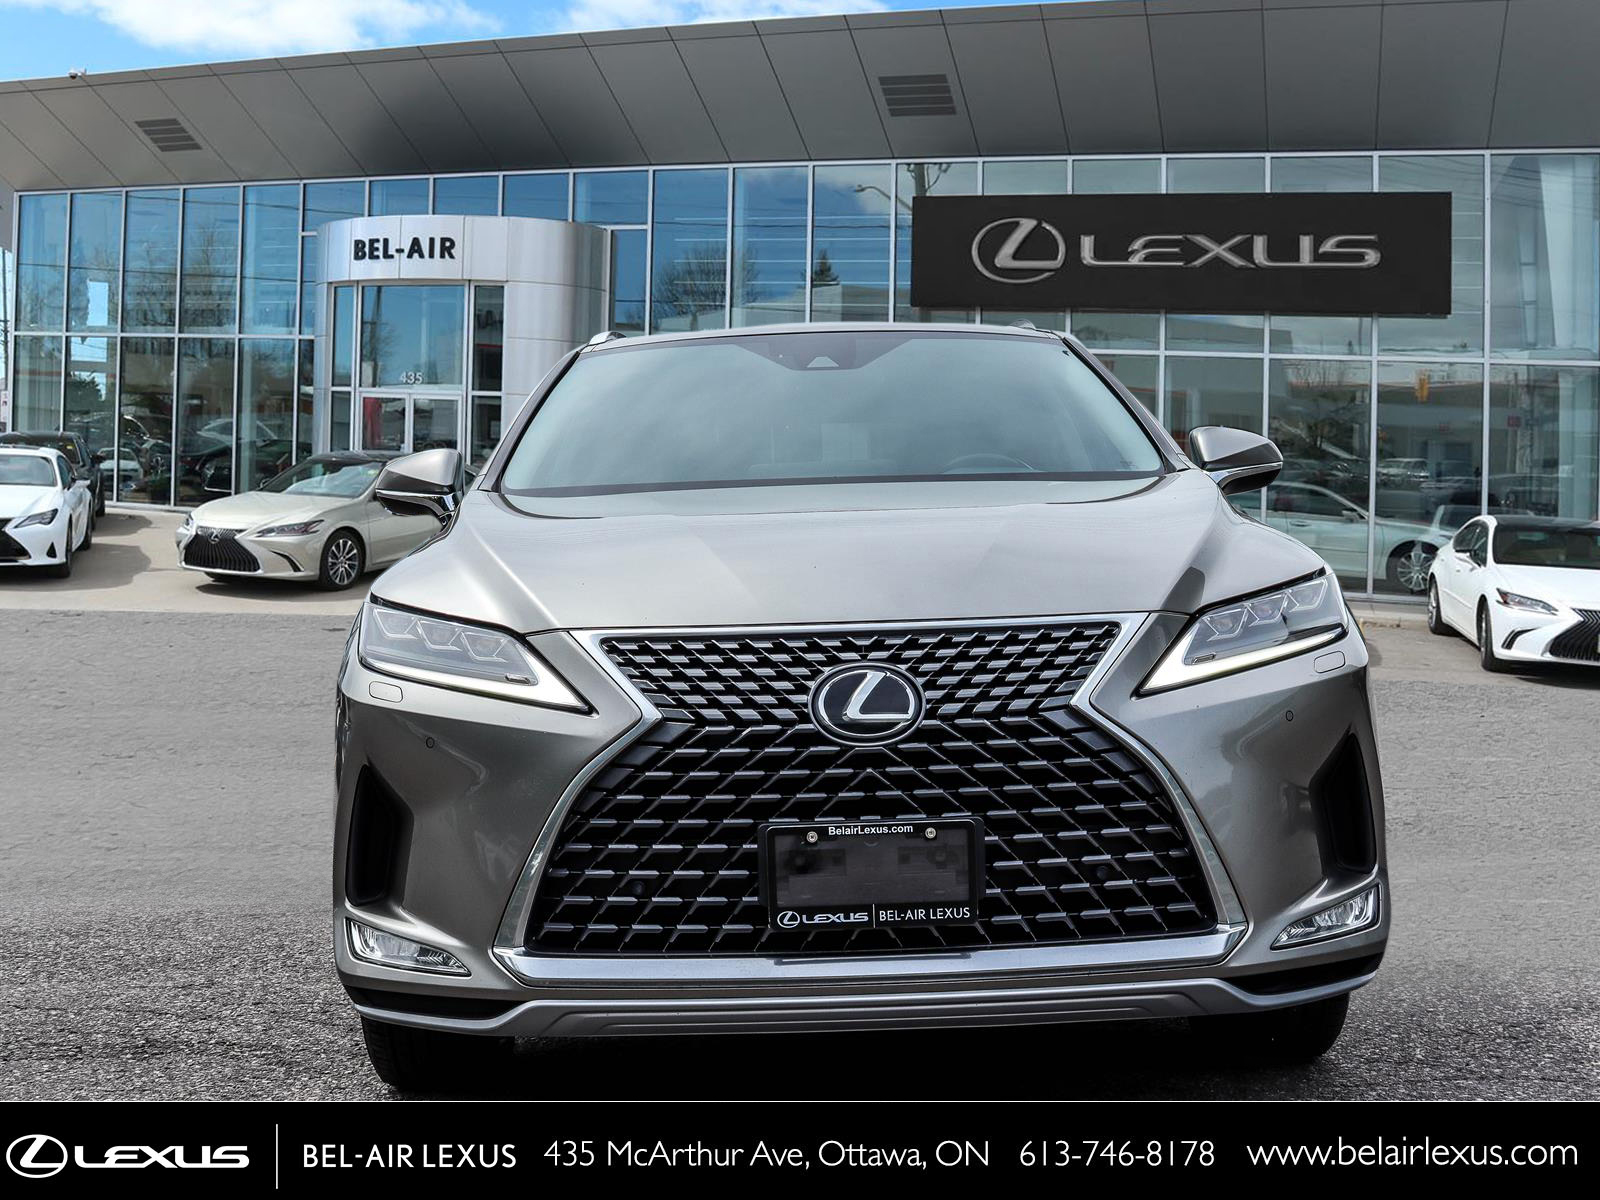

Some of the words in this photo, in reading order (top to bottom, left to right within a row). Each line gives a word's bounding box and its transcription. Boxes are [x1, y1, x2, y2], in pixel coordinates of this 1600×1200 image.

[353, 237, 456, 260] BEL-AIR
[1080, 233, 1382, 269] LEXUS
[400, 371, 423, 384] 435
[828, 824, 914, 836] BelairLexus.com
[802, 912, 869, 924] LEXUS
[879, 908, 927, 921] BEL-AIR
[929, 907, 971, 920] LEXUS
